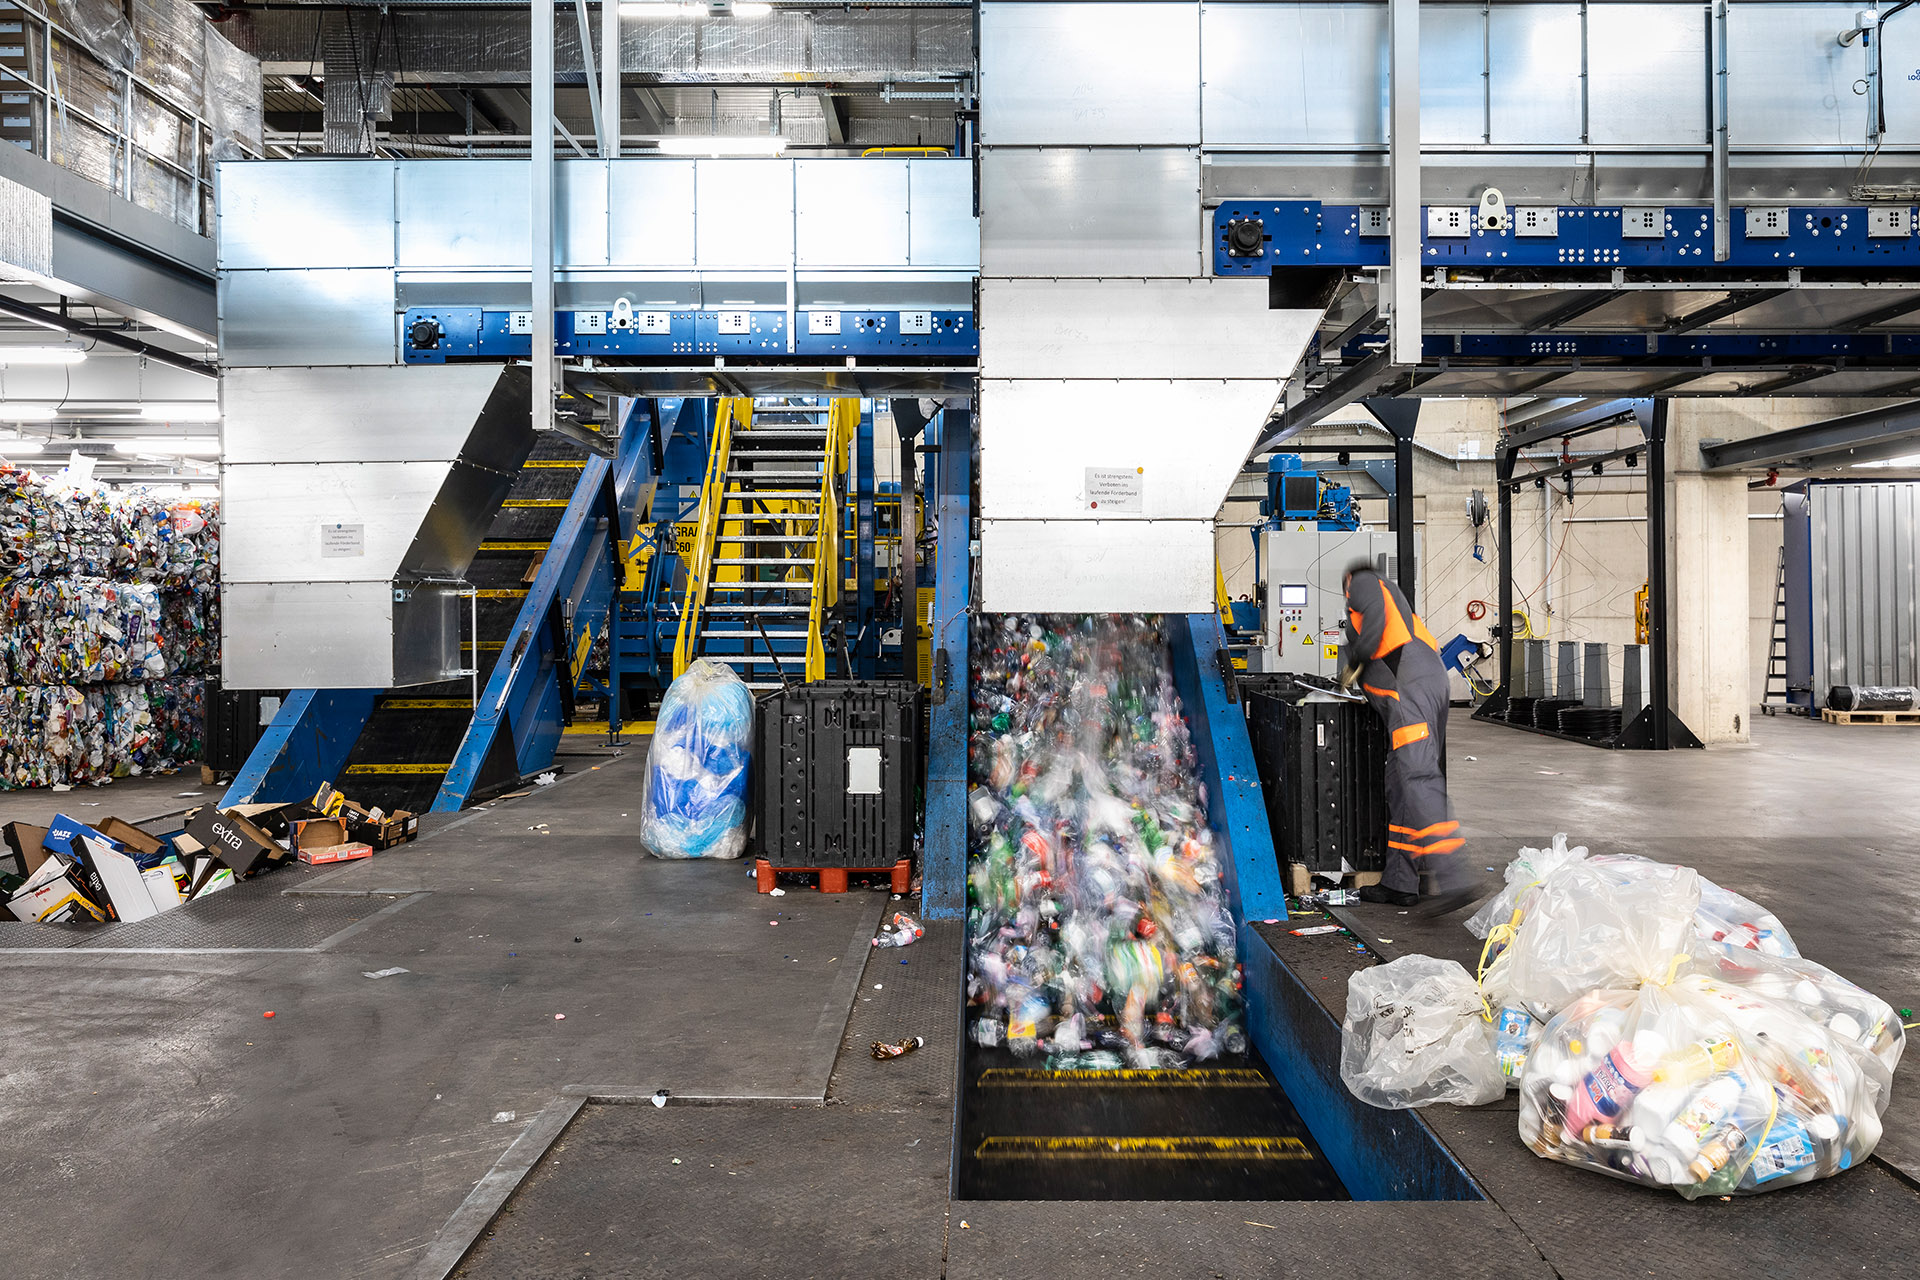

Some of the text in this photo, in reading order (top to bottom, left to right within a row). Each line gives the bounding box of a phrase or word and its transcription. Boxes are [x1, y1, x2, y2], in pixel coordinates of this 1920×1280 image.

[212, 823, 243, 850] extra
[315, 853, 336, 861] ENERGY
[350, 848, 370, 856] ENERGY
